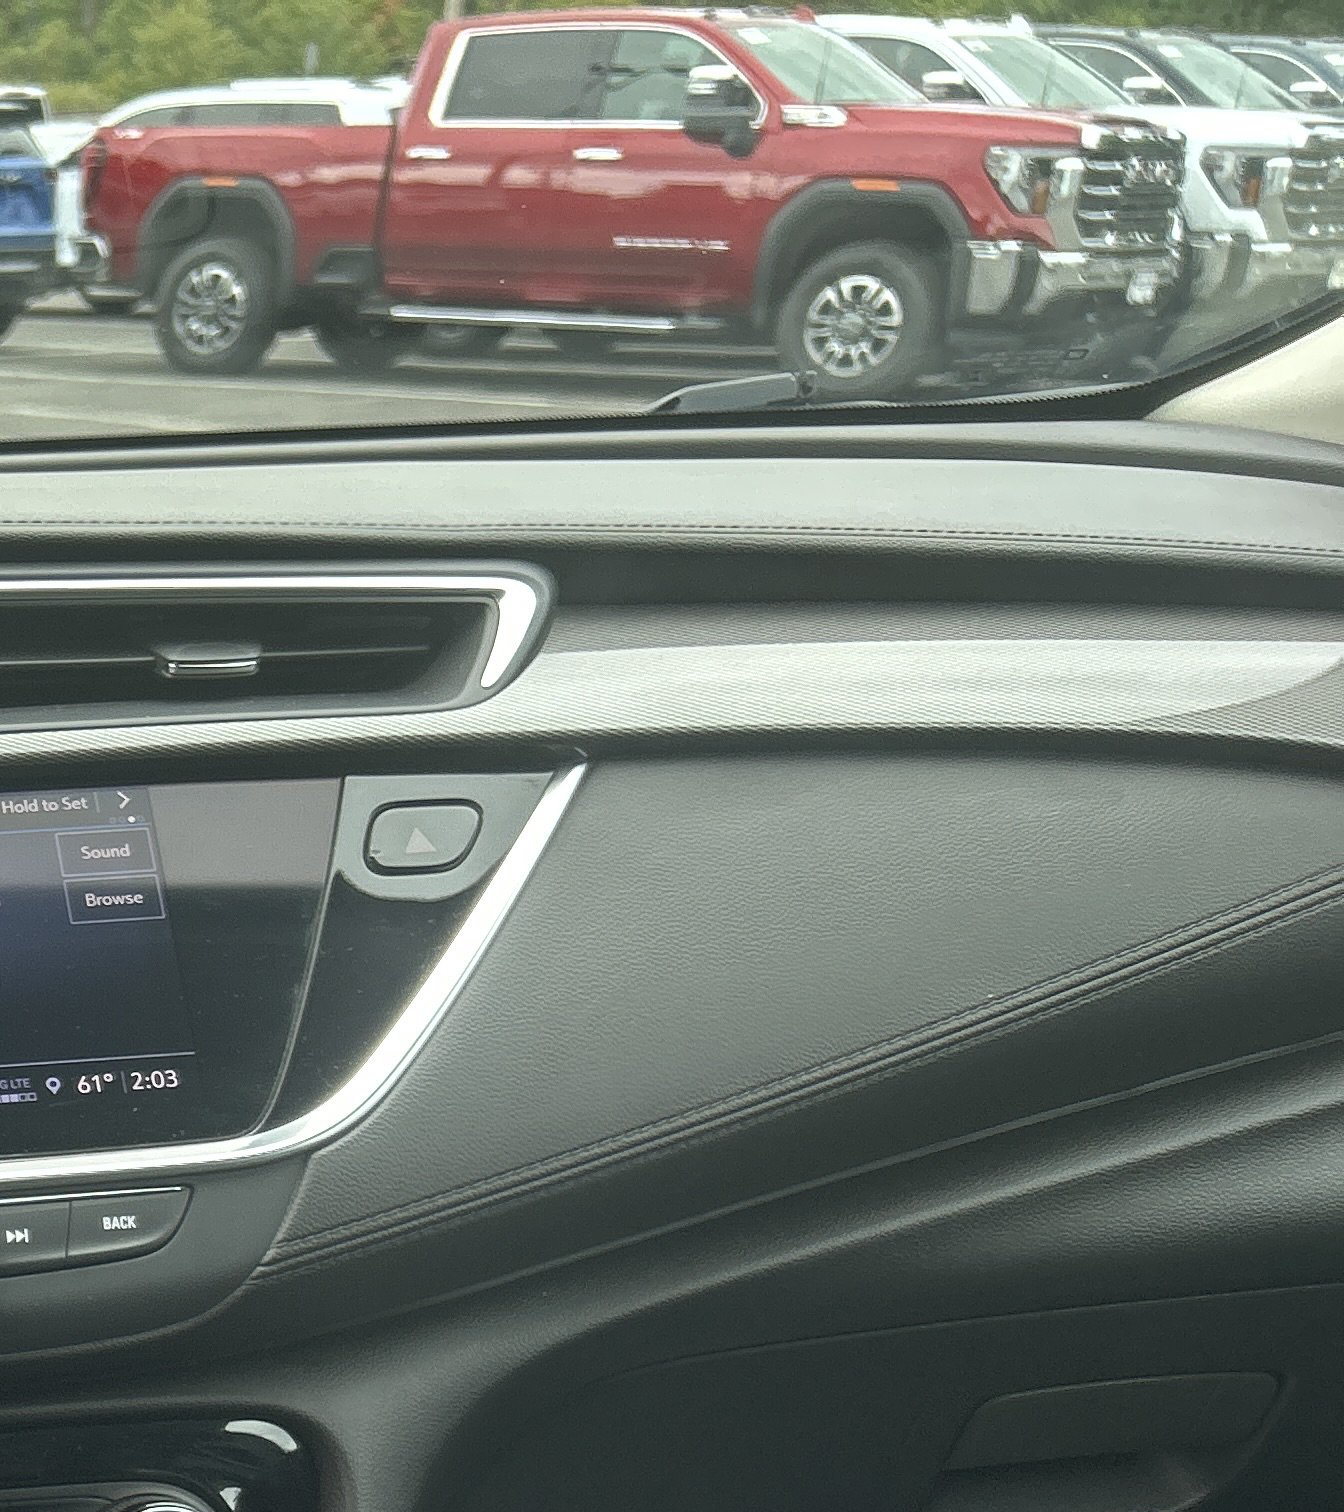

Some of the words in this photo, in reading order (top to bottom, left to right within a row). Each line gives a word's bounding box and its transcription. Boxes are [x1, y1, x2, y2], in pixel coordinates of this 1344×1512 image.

[1, 799, 39, 814] Hold
[42, 800, 59, 812] to
[62, 797, 88, 810] Set
[80, 844, 130, 860] Sound
[85, 893, 144, 907] Browse
[10, 1078, 31, 1089] LTE
[77, 1073, 113, 1094] 61°
[130, 1070, 179, 1091] 2:03
[102, 1215, 137, 1231] BACK
